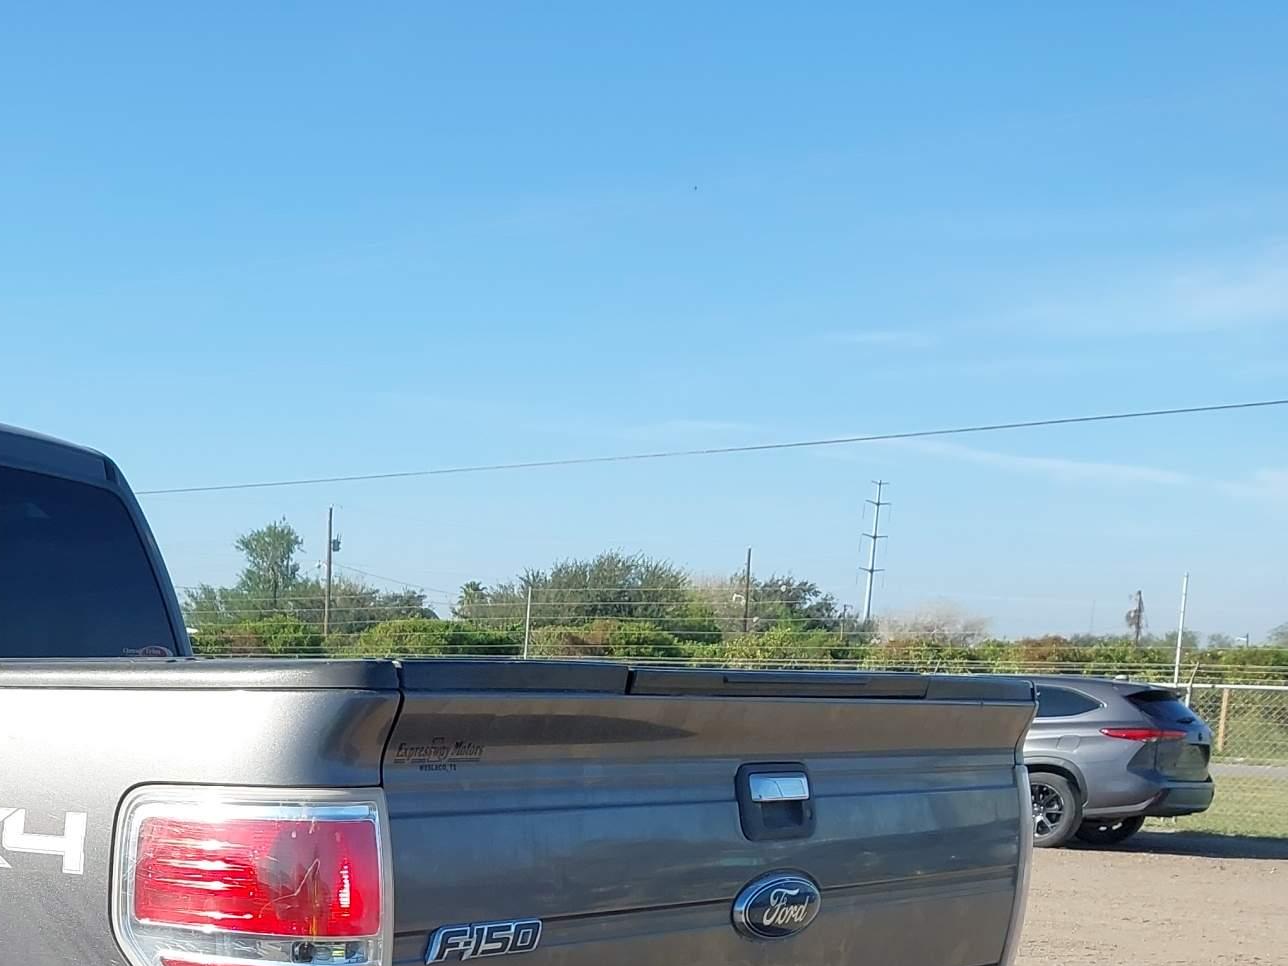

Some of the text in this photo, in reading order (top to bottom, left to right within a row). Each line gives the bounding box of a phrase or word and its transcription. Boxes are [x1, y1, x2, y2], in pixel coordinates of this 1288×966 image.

[452, 741, 485, 756] Motors
[763, 888, 810, 926] Ford
[426, 919, 542, 965] F-150
